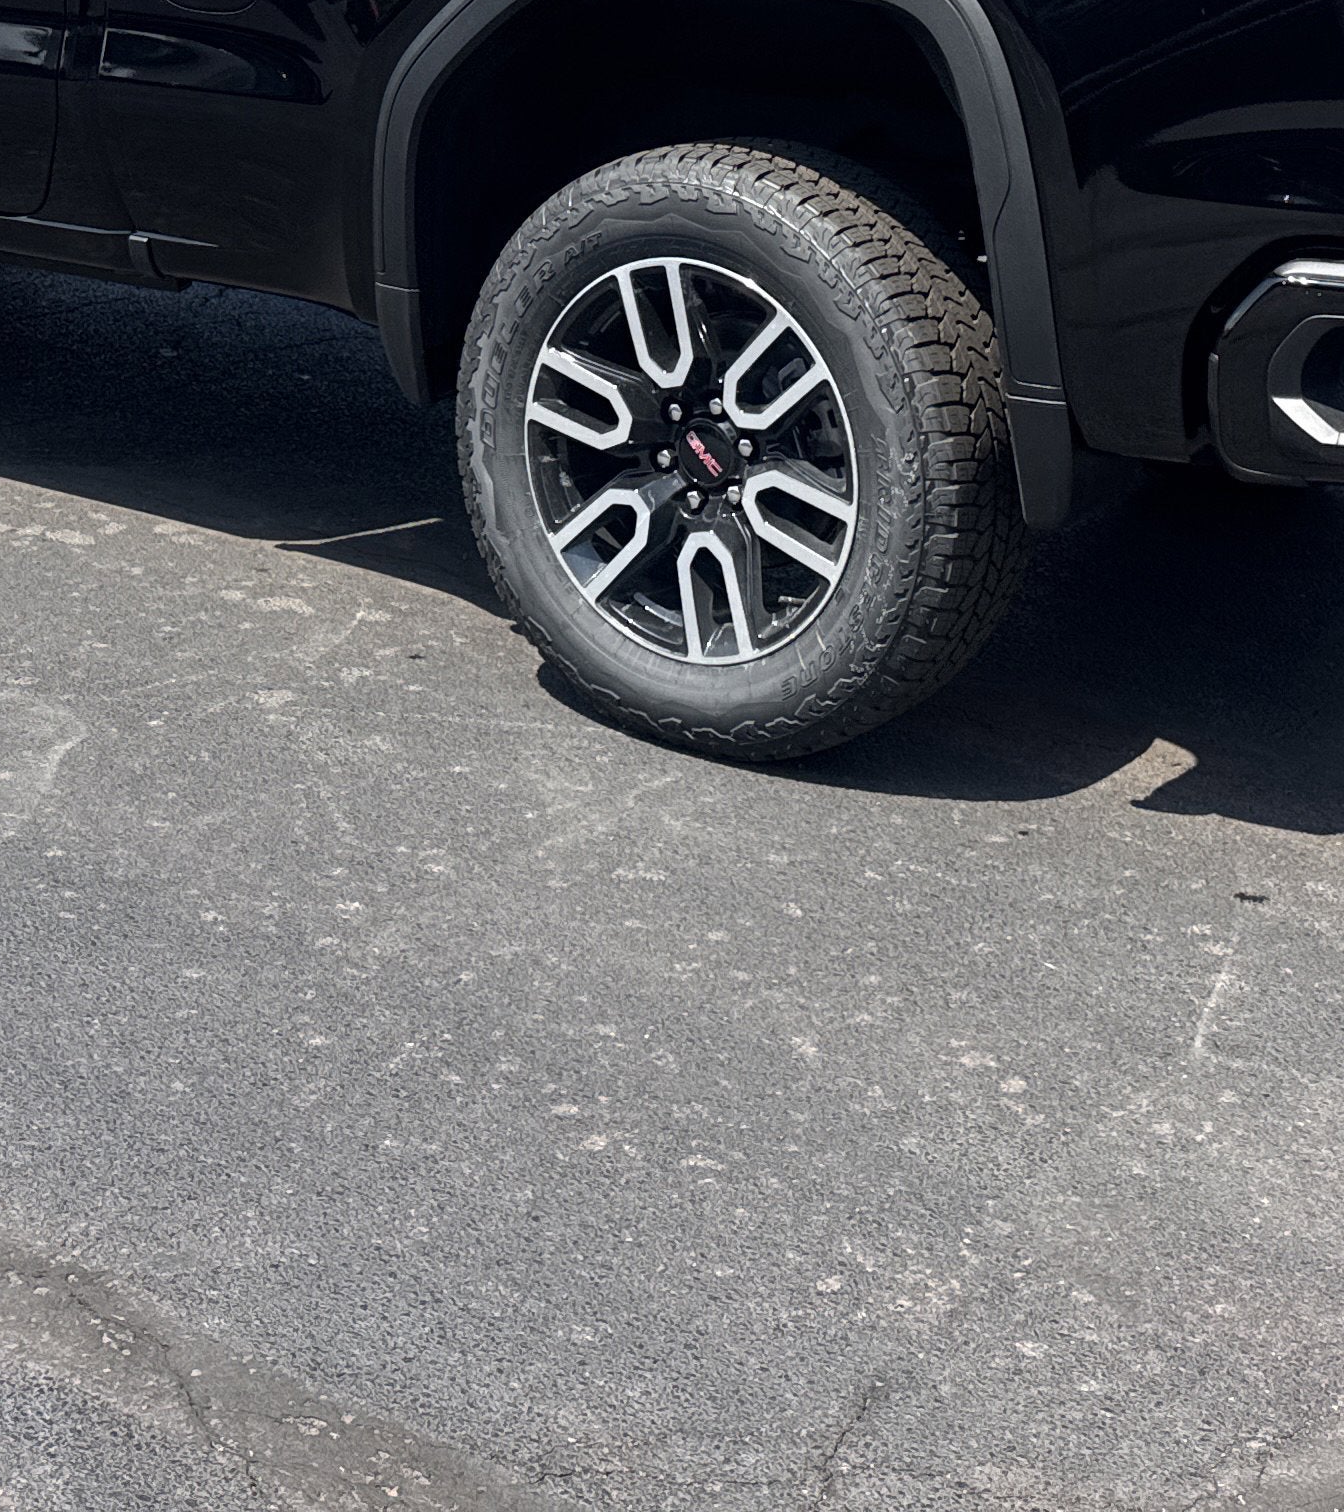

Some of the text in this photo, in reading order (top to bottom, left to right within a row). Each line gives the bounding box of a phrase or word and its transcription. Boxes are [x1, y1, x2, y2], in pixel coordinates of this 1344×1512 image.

[480, 258, 557, 449] DUELER
[562, 231, 603, 265] A/T
[686, 430, 723, 477] GMC
